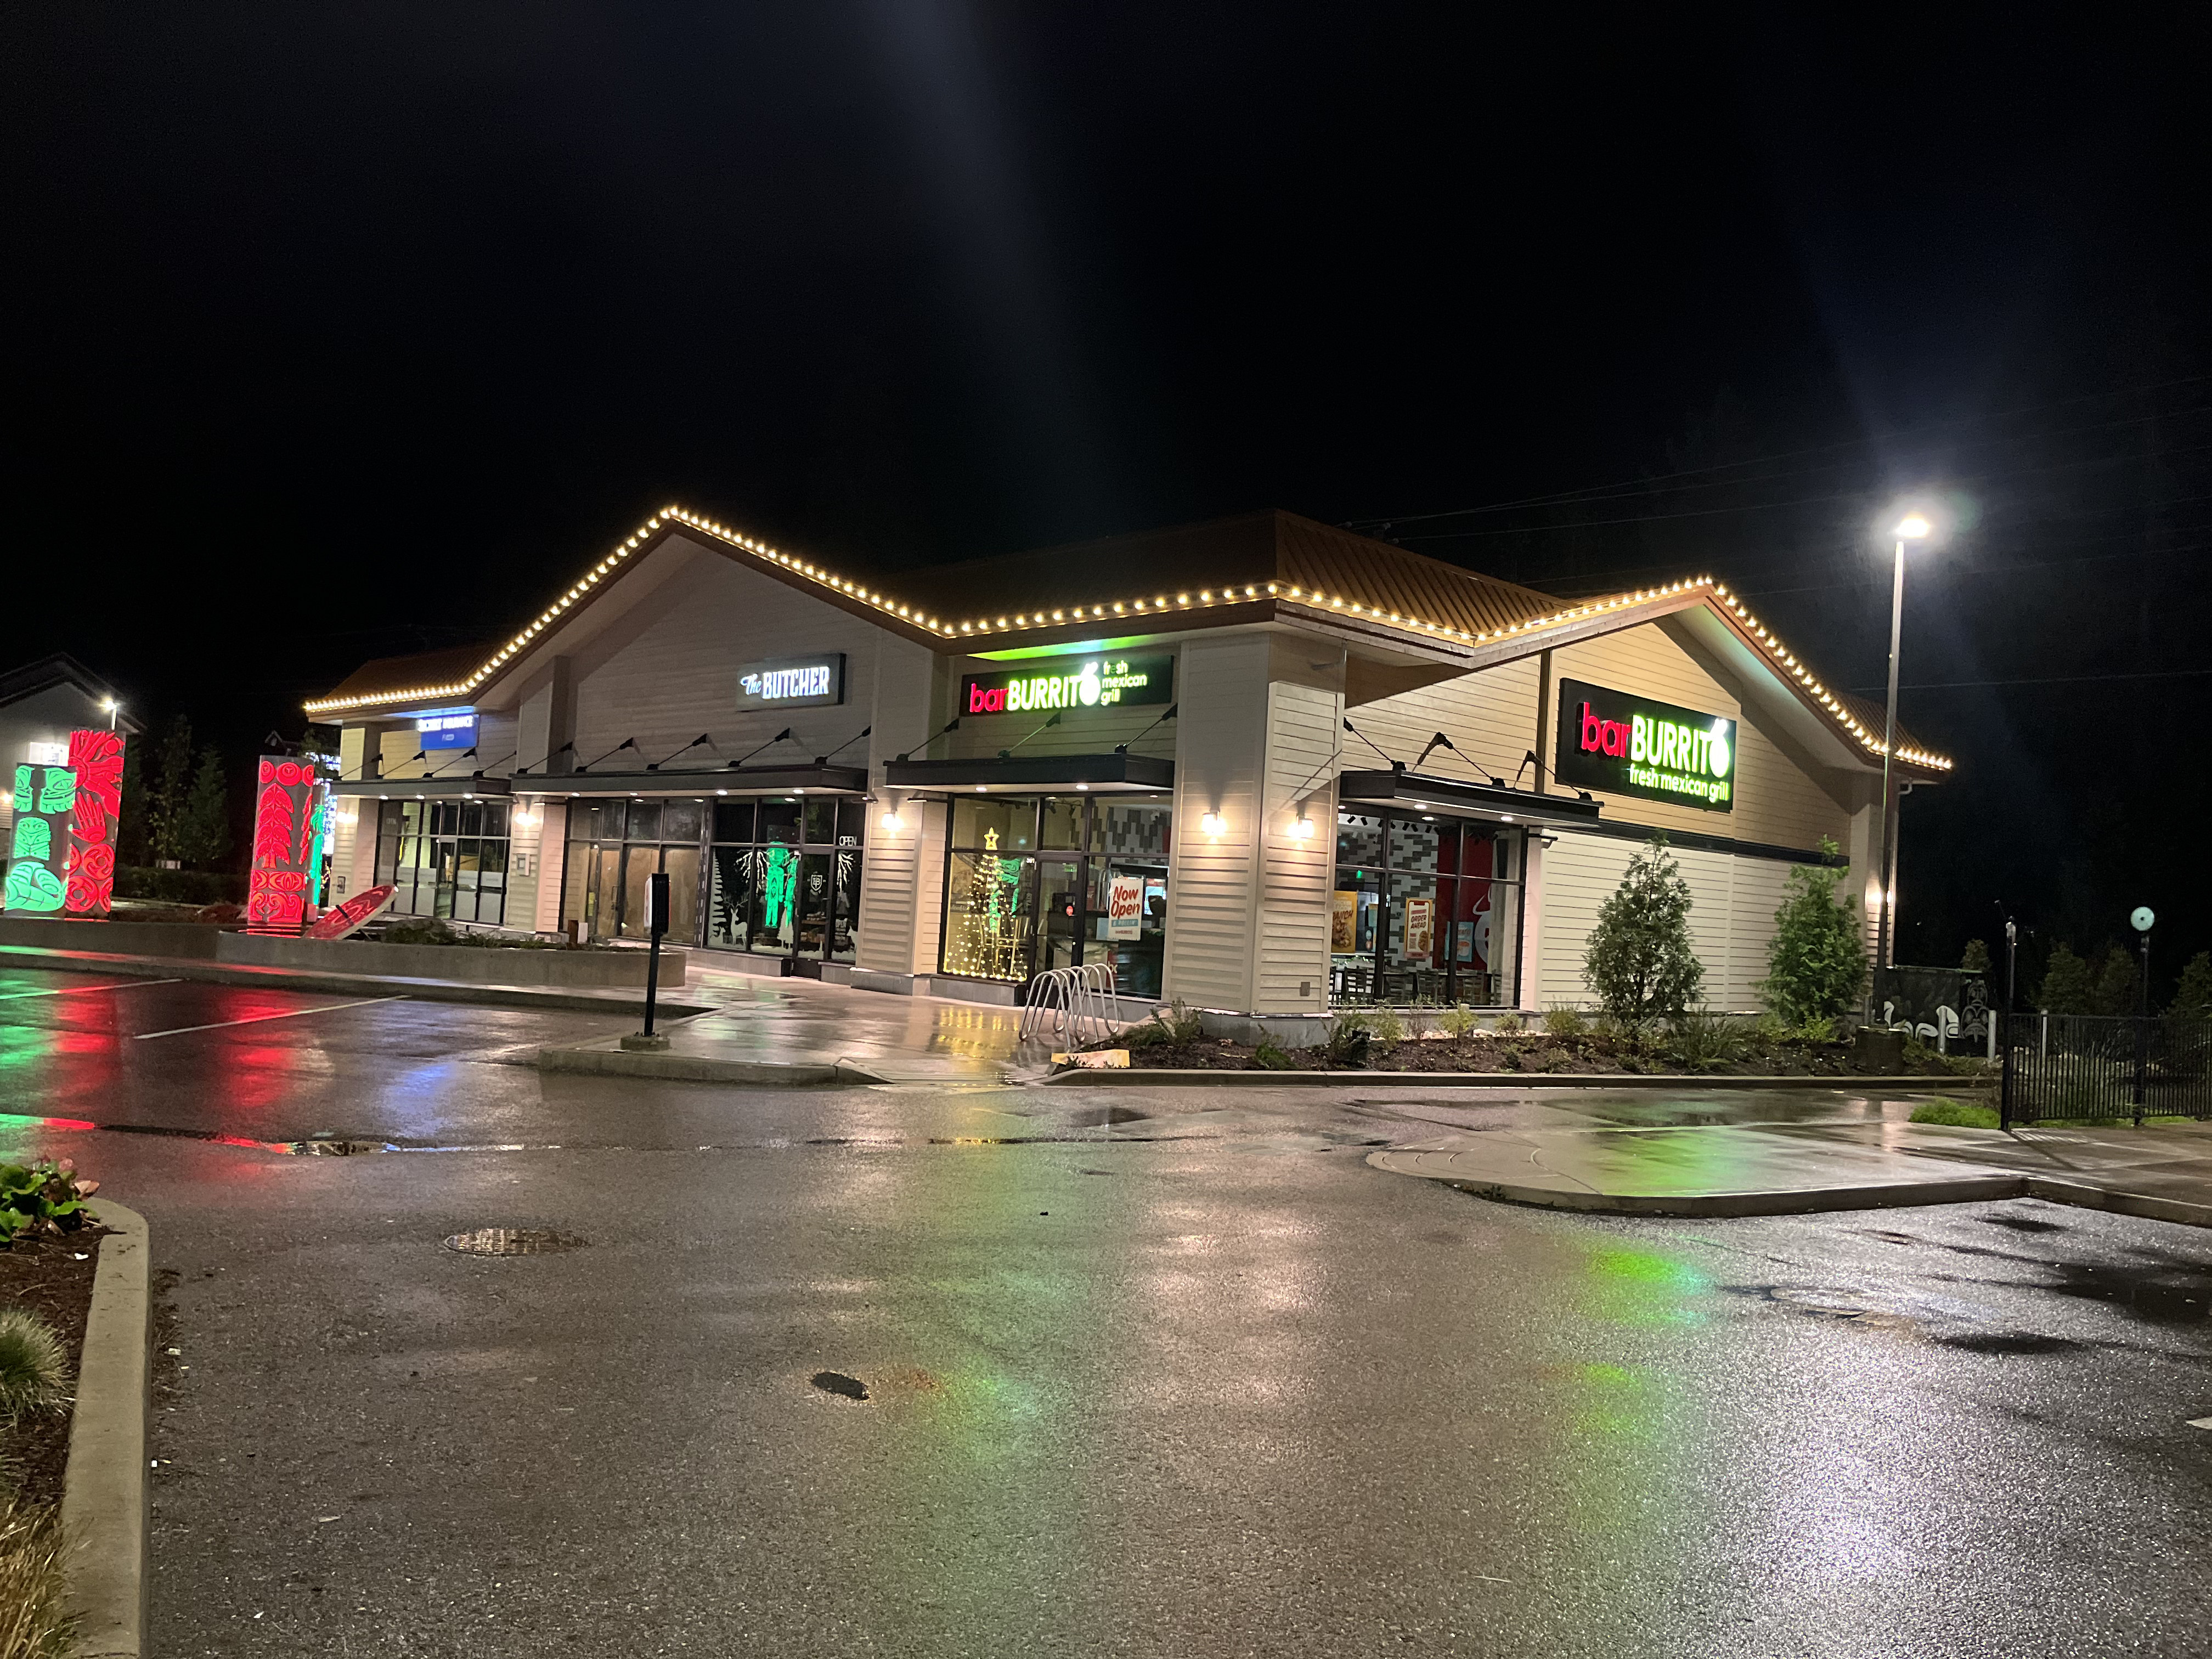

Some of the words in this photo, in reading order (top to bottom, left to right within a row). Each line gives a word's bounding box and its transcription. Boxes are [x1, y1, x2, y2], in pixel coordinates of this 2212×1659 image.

[1103, 659, 1128, 676] fresh
[740, 673, 762, 695] The
[762, 666, 830, 700] BUTCHER
[1101, 674, 1148, 689] mexican
[1100, 688, 1120, 707] grill
[1629, 763, 1659, 788] fresh
[1660, 773, 1708, 797] mexican
[1708, 781, 1729, 803] grill
[839, 836, 857, 847] OPEN
[1113, 885, 1139, 901] Now
[1110, 900, 1141, 919] Open
[1410, 915, 1427, 923] ORDER
